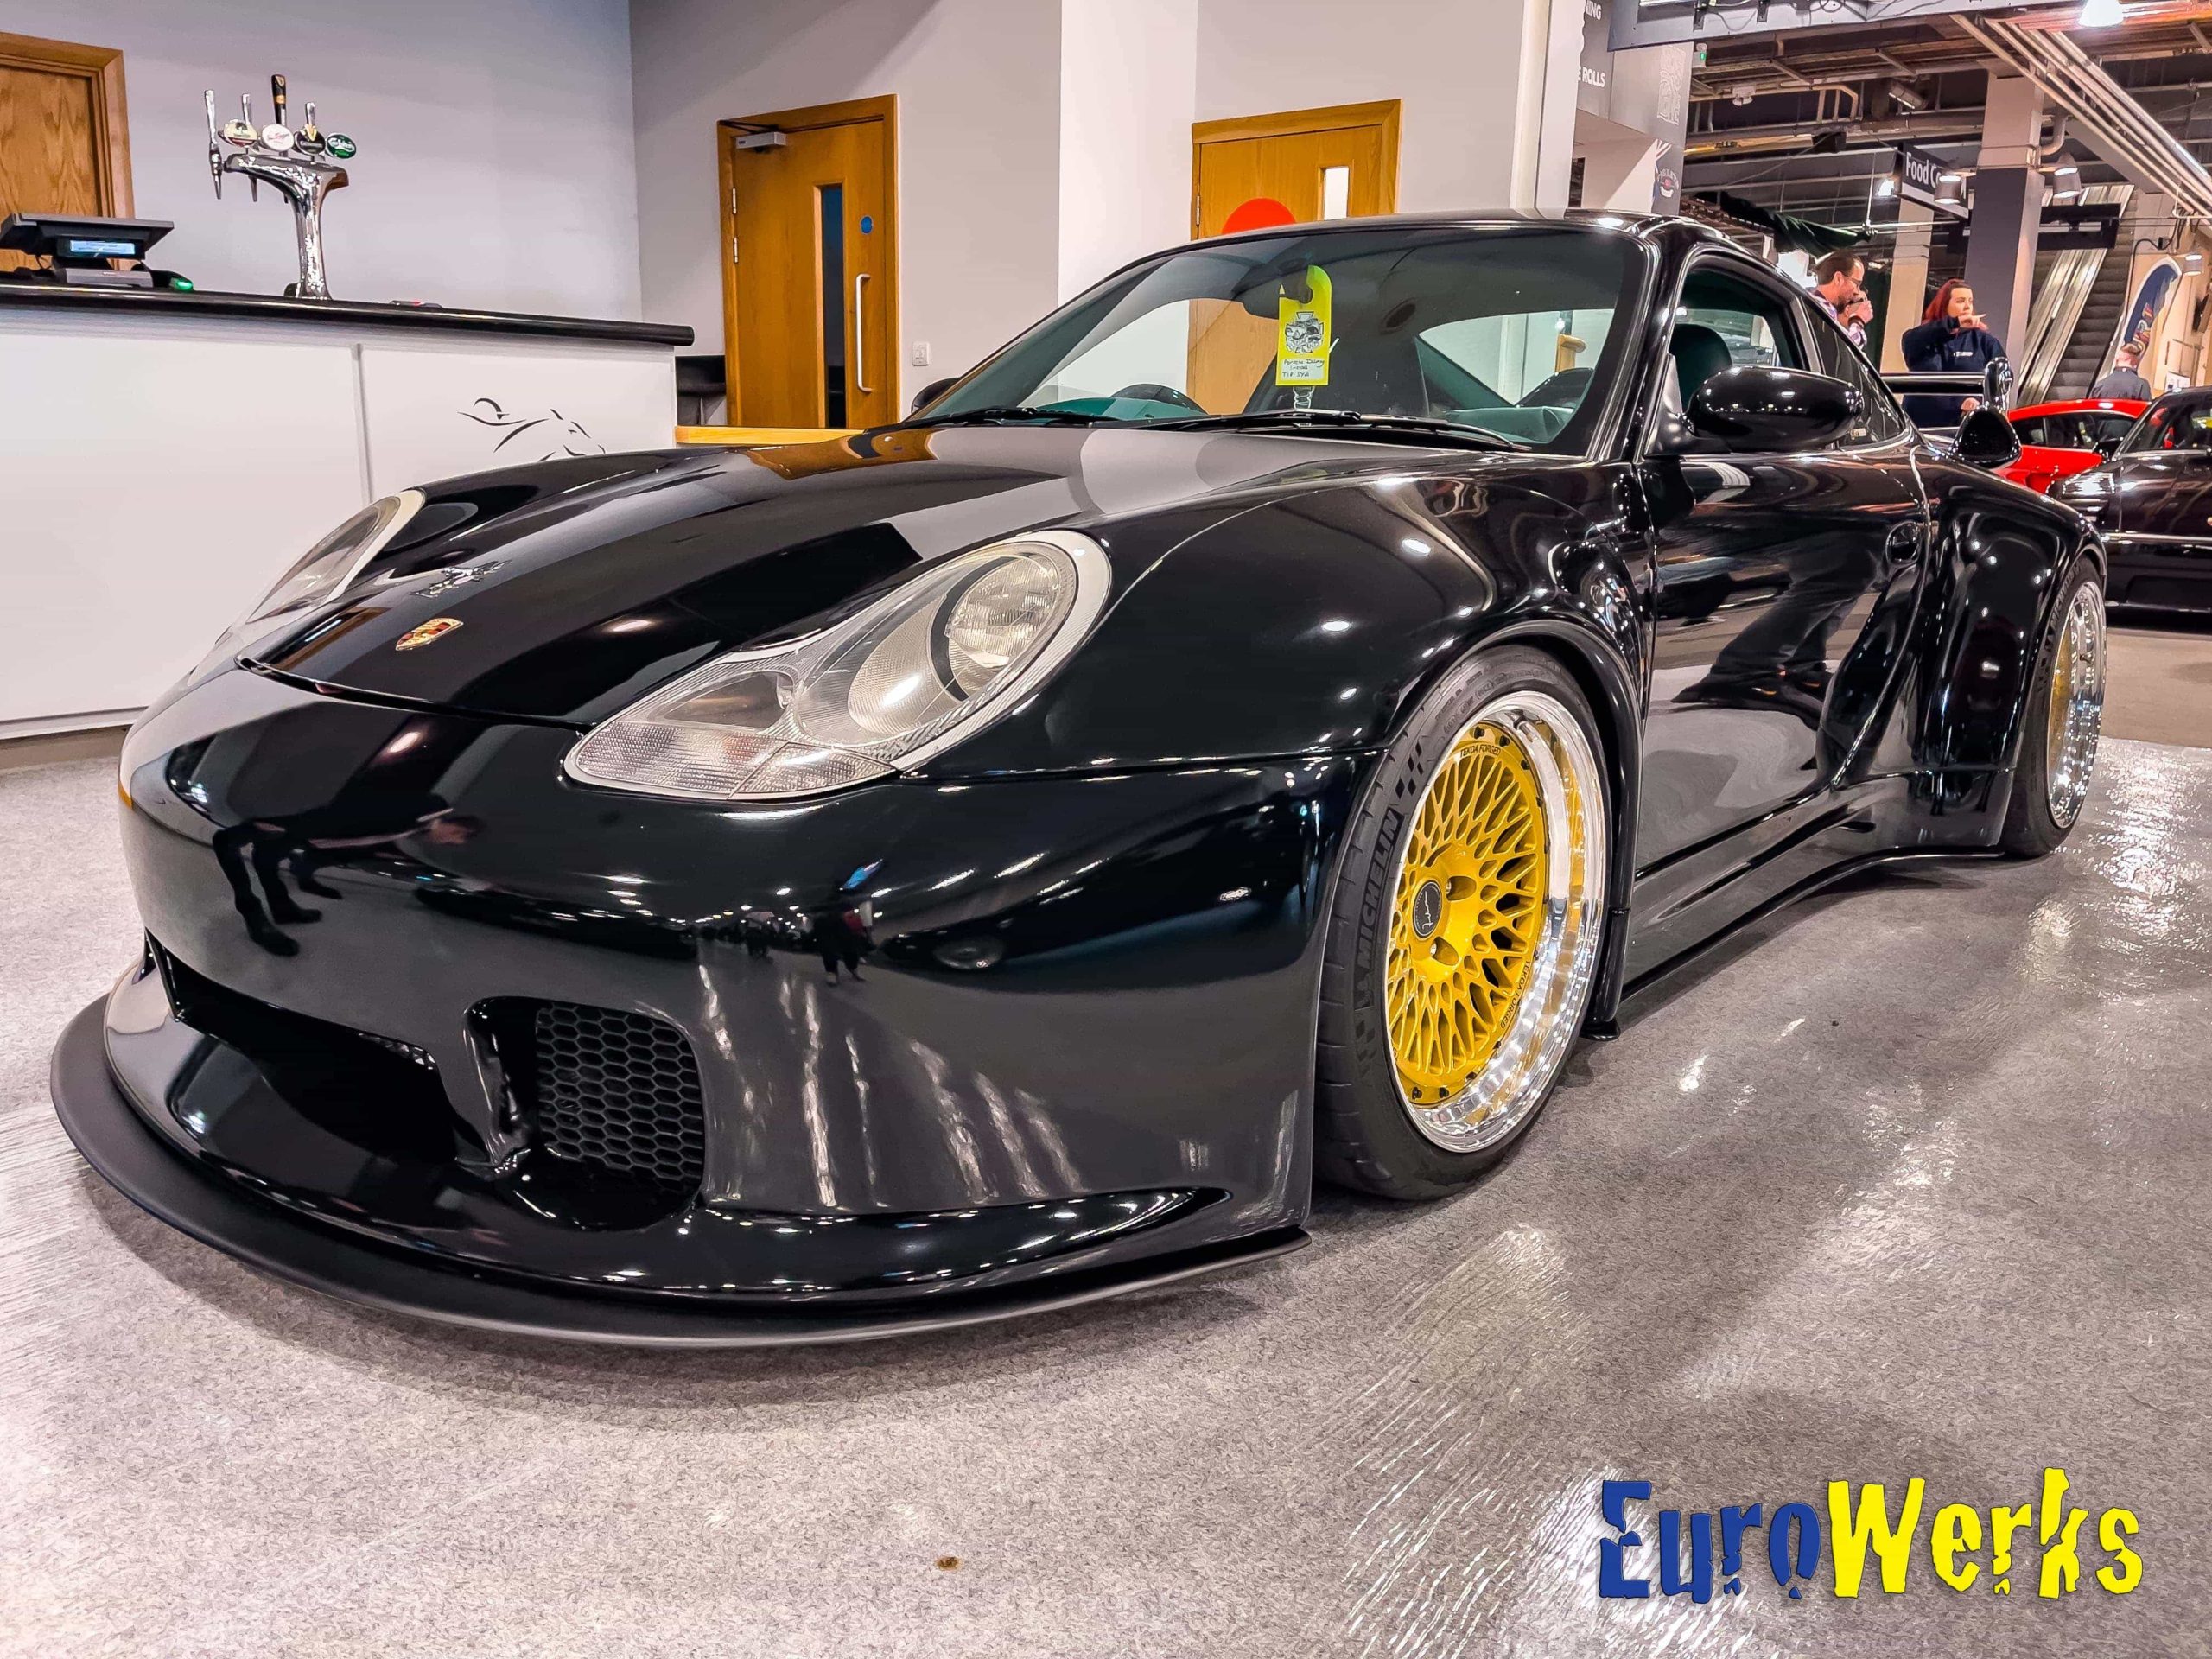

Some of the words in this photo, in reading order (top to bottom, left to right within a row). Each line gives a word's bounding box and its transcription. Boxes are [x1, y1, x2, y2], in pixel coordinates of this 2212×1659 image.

[1582, 67, 1605, 88] ROLLS
[1906, 151, 1929, 185] Food
[1357, 806, 1403, 970] MICHELIN
